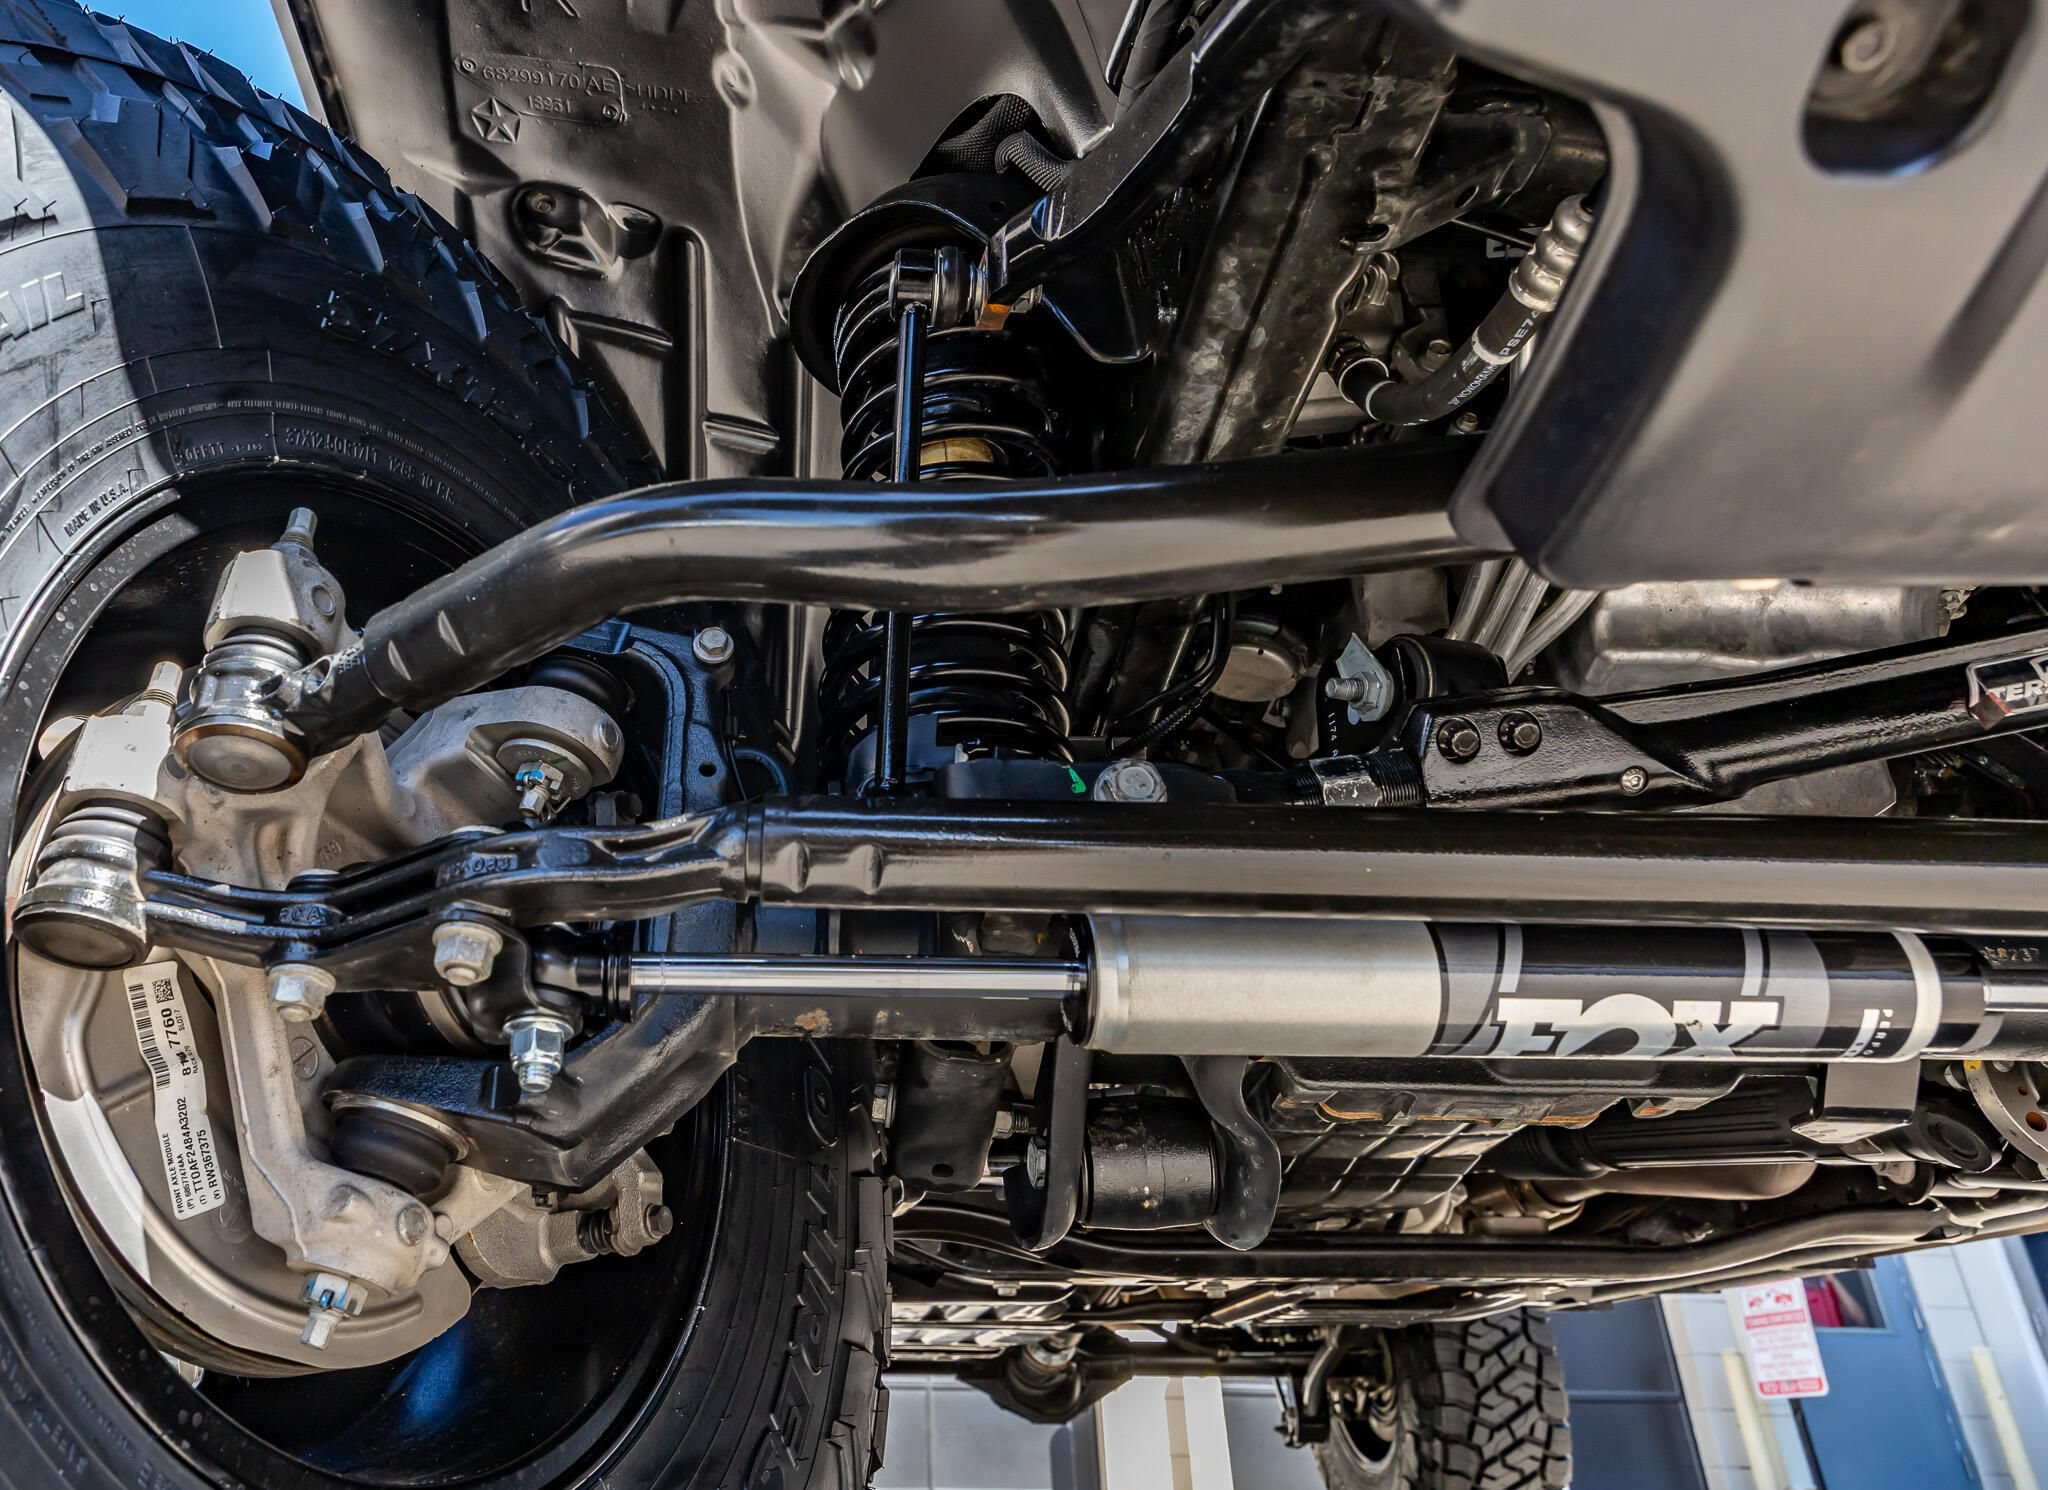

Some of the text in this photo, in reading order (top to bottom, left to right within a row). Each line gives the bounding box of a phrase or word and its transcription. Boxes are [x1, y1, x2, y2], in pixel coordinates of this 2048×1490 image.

[64, 507, 91, 538] MADE
[88, 496, 102, 516] IN
[161, 1007, 181, 1049] 7760
[162, 1133, 185, 1214] FRONT AXLE MODULE
[196, 1129, 218, 1189] RW367375
